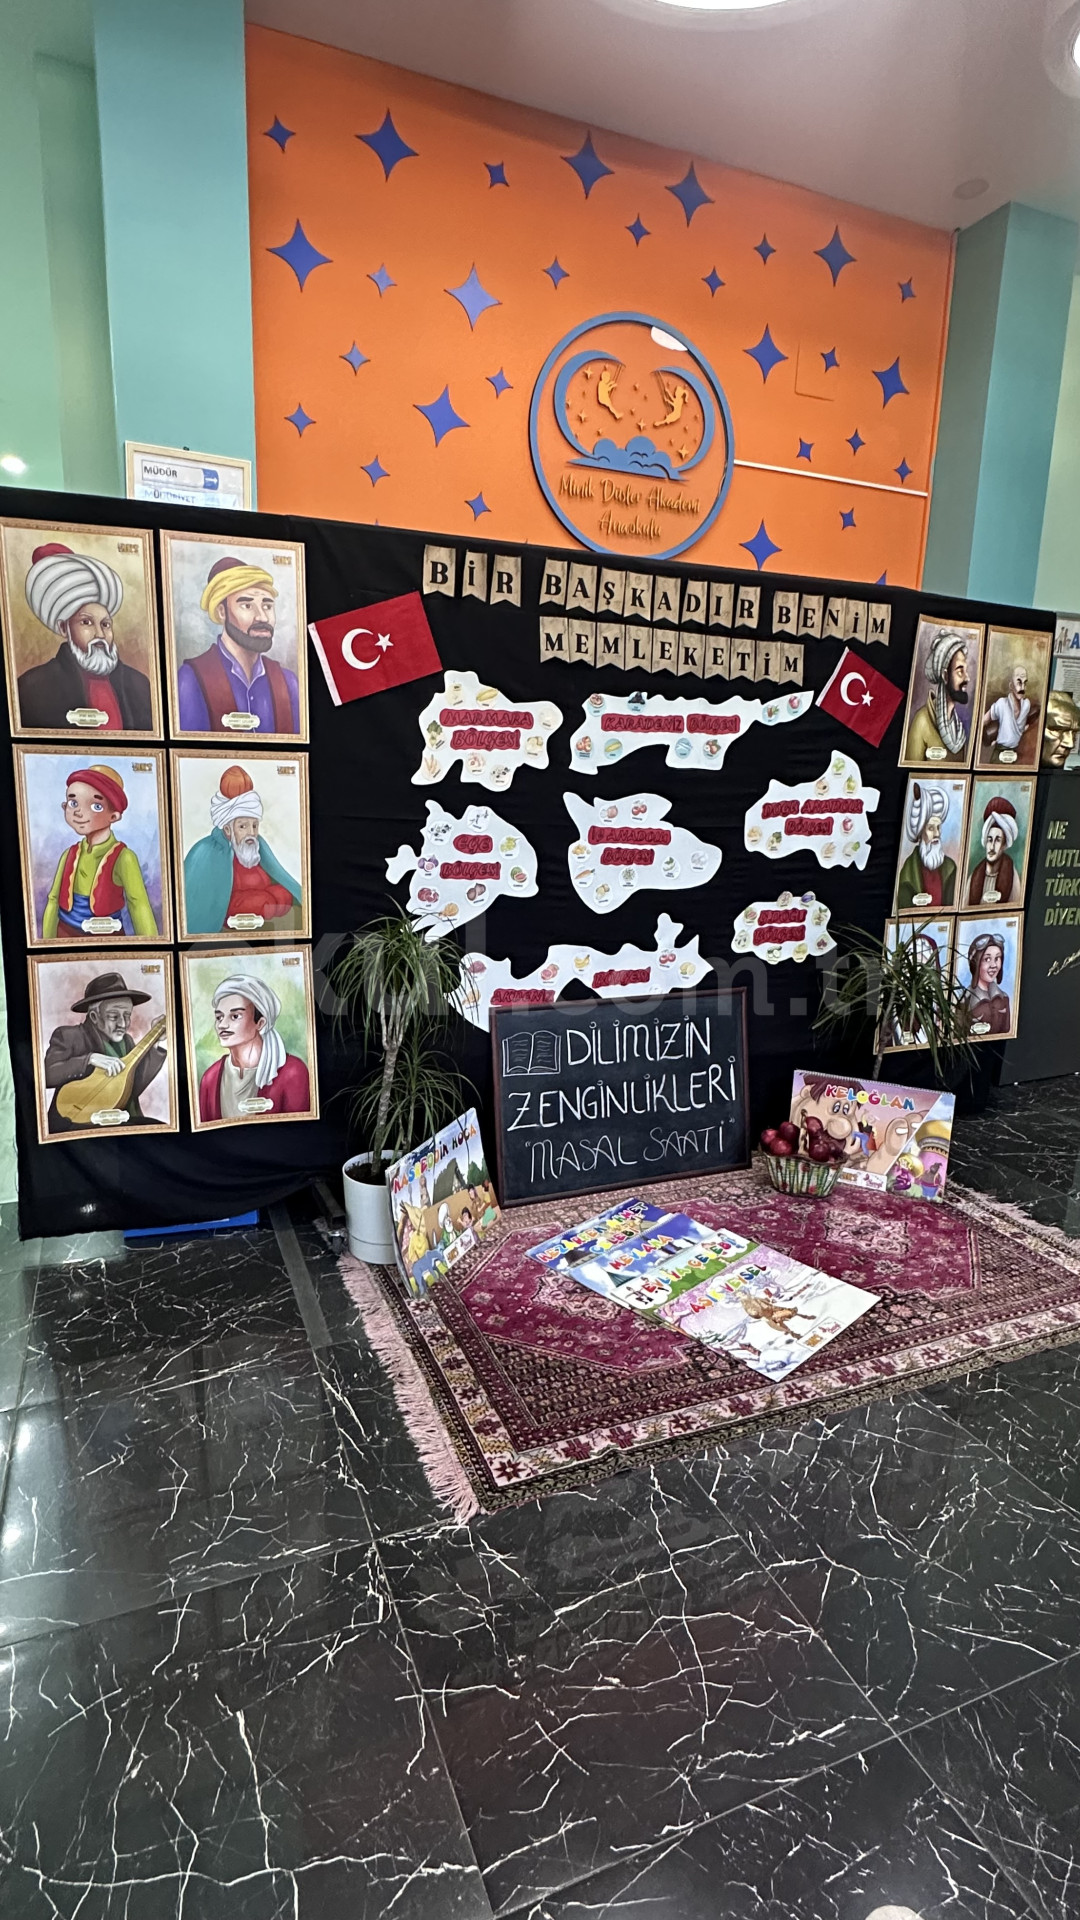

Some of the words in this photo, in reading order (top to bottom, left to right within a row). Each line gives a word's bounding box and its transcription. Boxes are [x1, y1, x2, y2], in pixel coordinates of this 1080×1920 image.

[143, 465, 178, 478] MÜDÜR
[429, 560, 514, 595] BİR
[545, 574, 755, 619] BAŞKADIR
[777, 605, 885, 634] BENİM
[545, 633, 798, 676] MEMLEKETİM
[443, 711, 532, 726] MARMARA
[1047, 821, 1069, 839] NE
[1045, 849, 1080, 867] MUTL
[1045, 873, 1080, 896] TÜRK
[566, 1015, 711, 1066] DİLİMİZİN
[506, 1056, 736, 1131] ZENGİNLİKLERİ
[825, 1084, 915, 1111] KELOĞLAN
[610, 1234, 673, 1270] MEVLANA
[724, 1265, 766, 1292] VEYSEL
